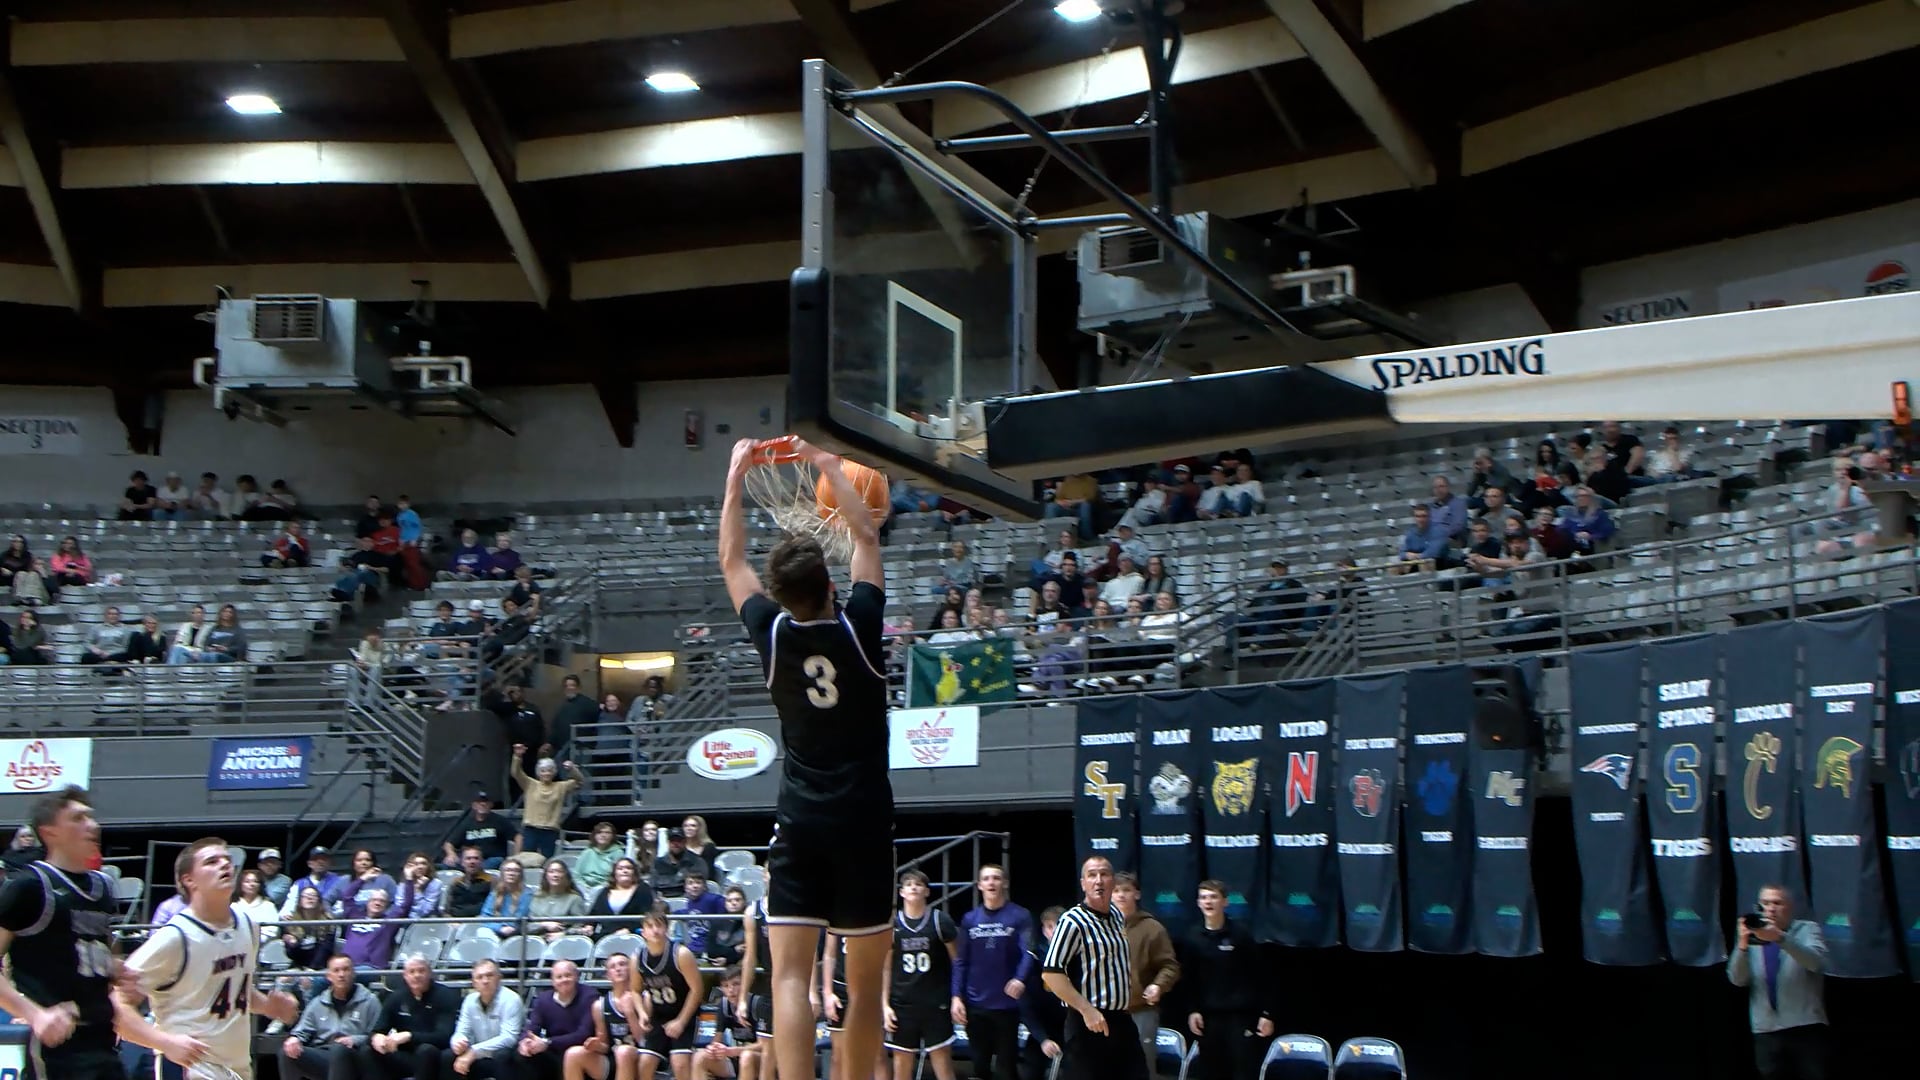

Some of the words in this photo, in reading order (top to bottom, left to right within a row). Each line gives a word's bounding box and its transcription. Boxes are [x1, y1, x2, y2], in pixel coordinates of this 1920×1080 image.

[1603, 297, 1689, 323] SECTION
[1372, 339, 1544, 392] SPALDING
[0, 418, 79, 434] SECTION
[803, 654, 839, 709] 3
[1080, 732, 1136, 746] SHERMAN
[1152, 729, 1191, 746] MAN
[1211, 725, 1263, 742] LOGAN
[1279, 720, 1328, 738] NITRO
[703, 740, 732, 758] Little
[221, 756, 302, 770] ANTOLINI
[711, 747, 758, 772] General
[5, 760, 63, 781] Arby's
[1286, 751, 1319, 817] N
[1650, 837, 1713, 857] TIGERS
[902, 951, 931, 974] 30
[210, 973, 249, 1020] 44
